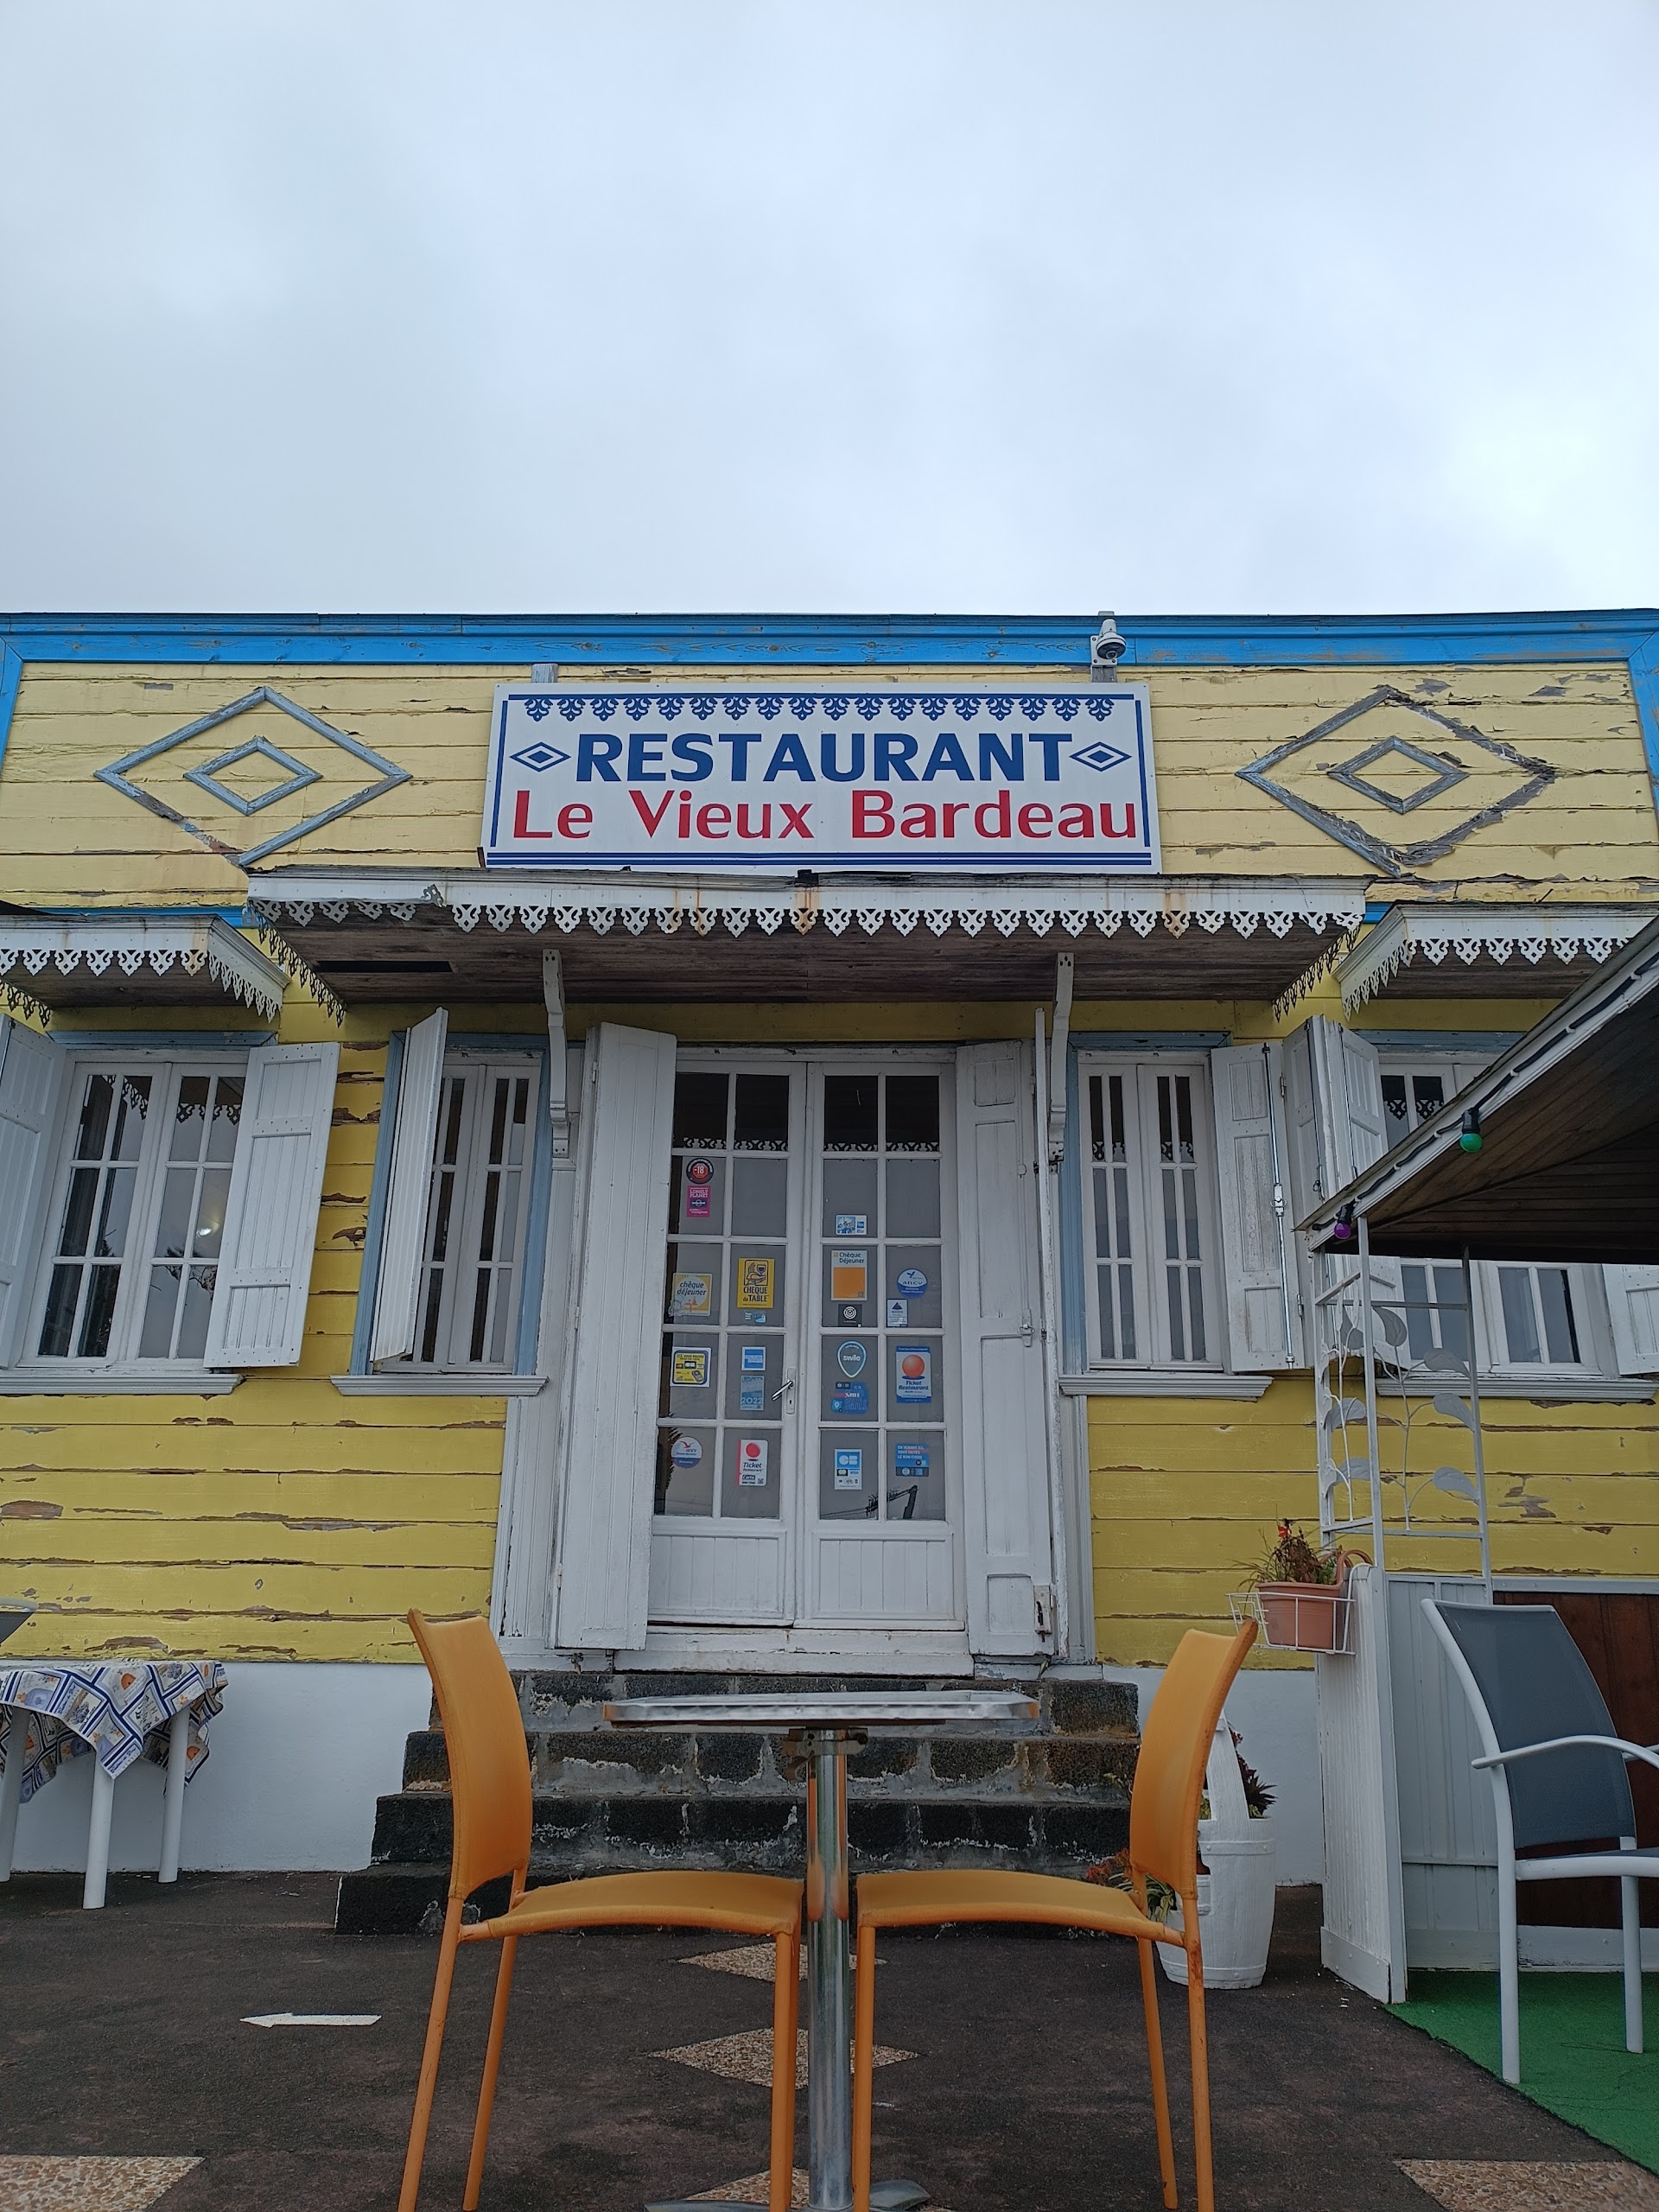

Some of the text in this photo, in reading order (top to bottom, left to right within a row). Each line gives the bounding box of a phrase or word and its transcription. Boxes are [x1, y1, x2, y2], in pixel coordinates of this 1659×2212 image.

[575, 732, 1073, 783] RESTAURANT
[513, 790, 1136, 839] Le Vieux Bardeau
[677, 1287, 707, 1296] déjeuner
[679, 1281, 704, 1289] chèque
